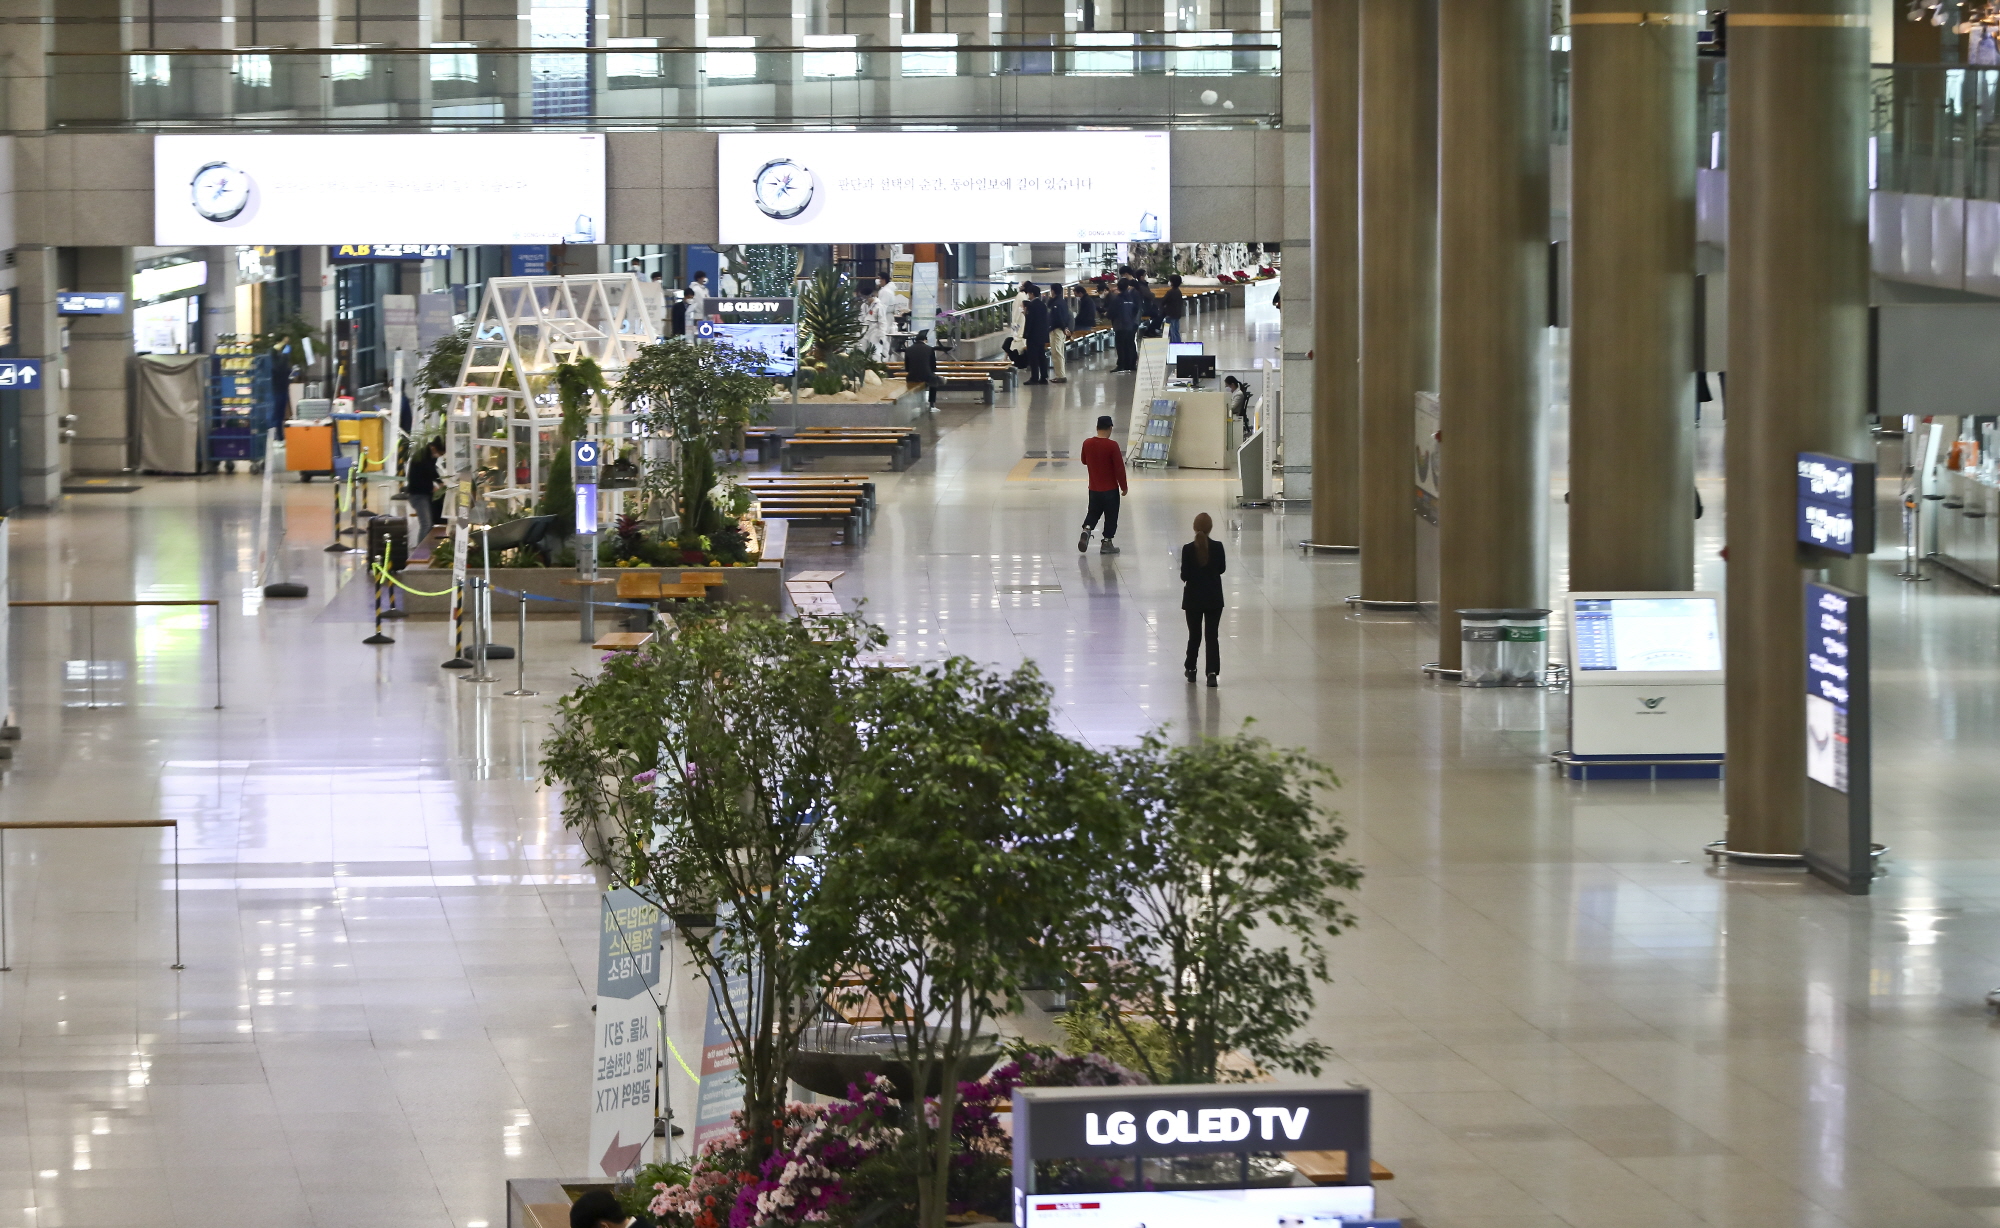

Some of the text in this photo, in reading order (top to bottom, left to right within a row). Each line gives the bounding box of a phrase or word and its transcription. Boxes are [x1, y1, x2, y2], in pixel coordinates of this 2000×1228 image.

[950, 177, 1011, 191] 동아일보에
[1016, 177, 1040, 190] 길이
[1044, 177, 1093, 190] 있습니다
[718, 302, 779, 312] LG OLED TV
[1086, 1107, 1310, 1145] LG OLED TV
